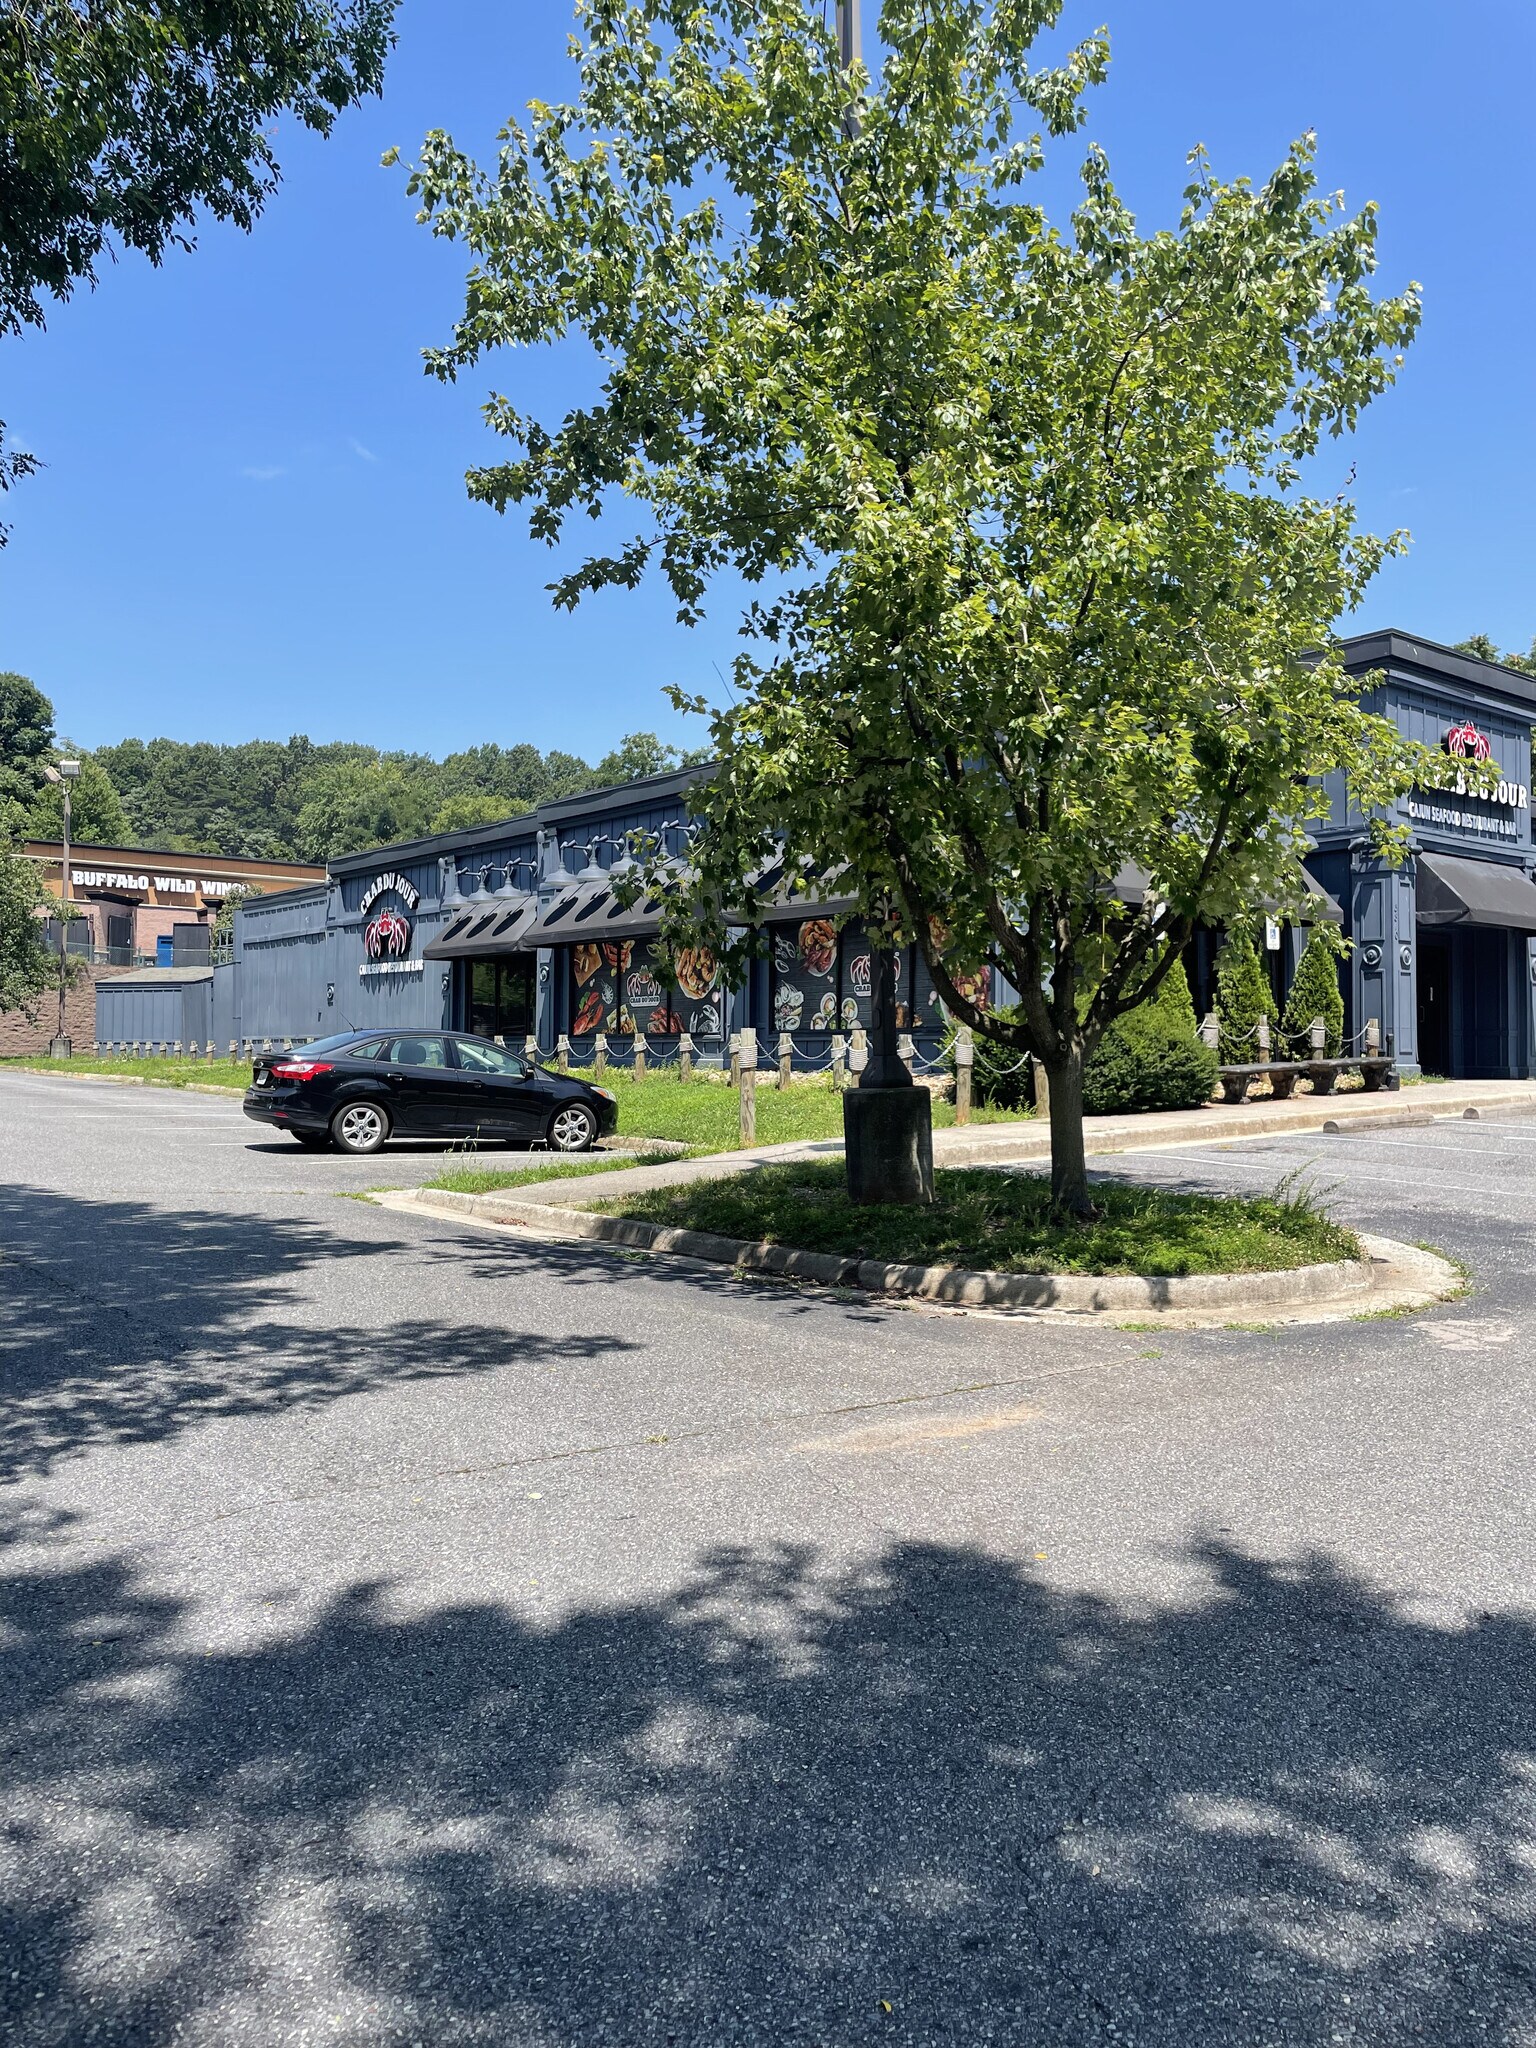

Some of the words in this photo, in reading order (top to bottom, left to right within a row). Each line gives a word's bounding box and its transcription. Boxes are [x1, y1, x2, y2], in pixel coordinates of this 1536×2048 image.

[1491, 779, 1528, 809] JOUR
[1408, 801, 1431, 821] CAJUN
[1431, 805, 1460, 827] SEAFOOD
[1461, 812, 1499, 833] RESTAURANT
[72, 870, 149, 890] BUFFALO
[154, 876, 196, 893] WILD
[360, 876, 383, 915] CRAB
[383, 872, 395, 890] DU
[395, 874, 419, 909] JOUR
